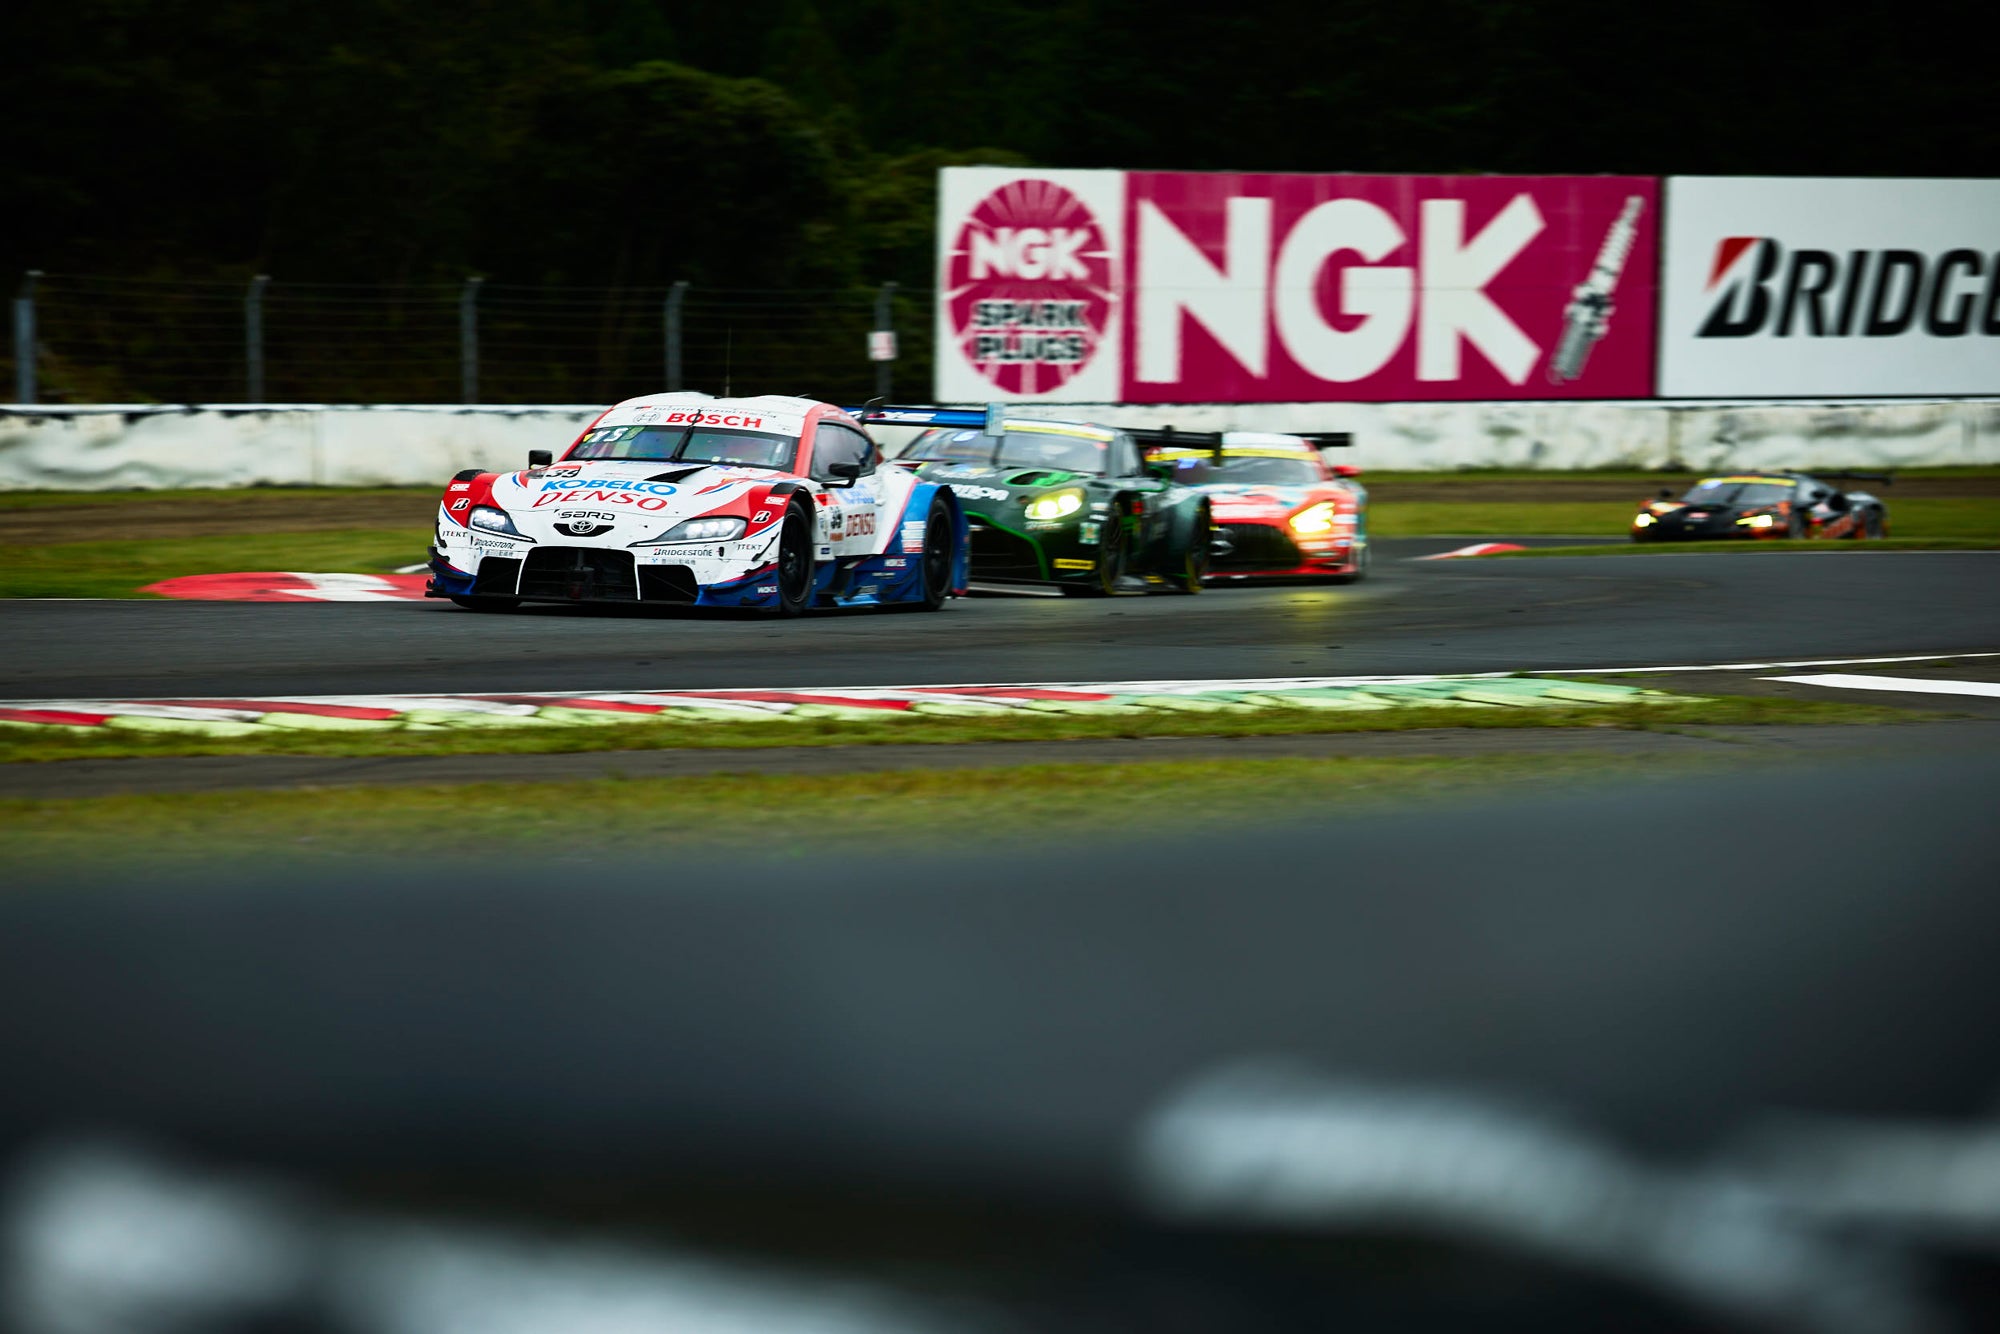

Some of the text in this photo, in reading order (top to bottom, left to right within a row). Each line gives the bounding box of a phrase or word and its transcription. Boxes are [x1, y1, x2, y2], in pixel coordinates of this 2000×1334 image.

[970, 227, 1091, 279] NGK
[1135, 194, 1547, 385] NGK
[973, 301, 1090, 327] SPARK
[973, 334, 1089, 361] PLUGS
[666, 412, 762, 428] BOSCH
[541, 480, 677, 496] KOBELCO
[532, 490, 668, 511] DENSO
[442, 530, 468, 538] JTEKT
[846, 513, 876, 537] DENSO
[653, 548, 713, 557] BRIDGESTONE
